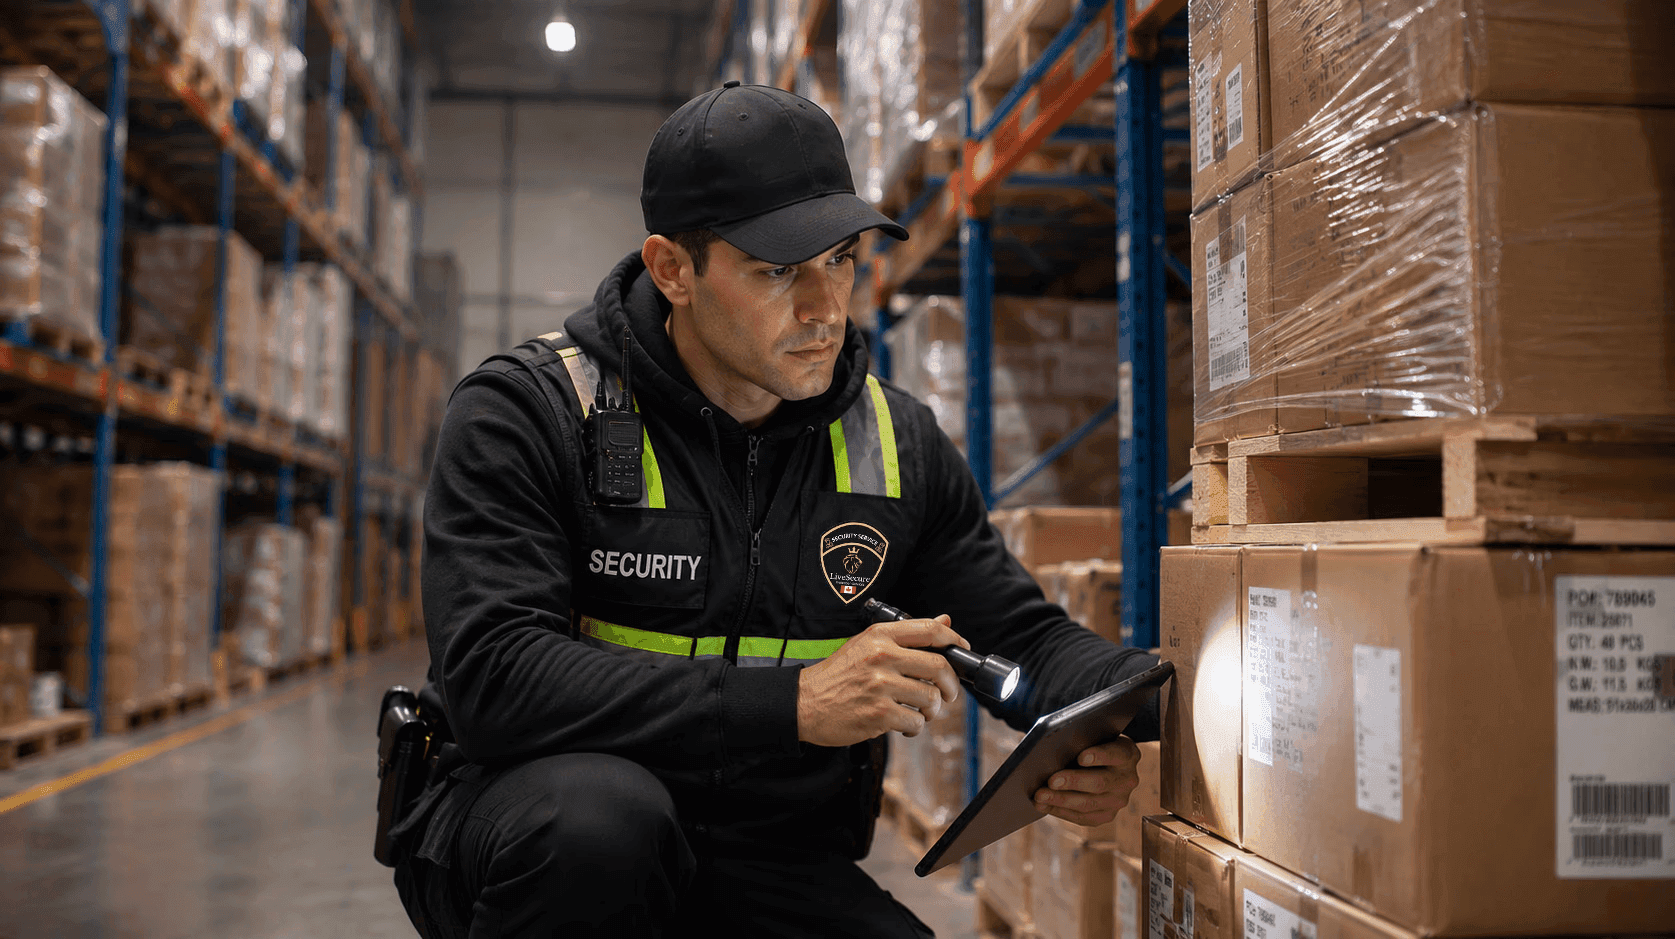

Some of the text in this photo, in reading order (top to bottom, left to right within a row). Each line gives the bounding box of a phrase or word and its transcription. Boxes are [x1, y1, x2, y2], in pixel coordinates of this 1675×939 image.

[831, 533, 857, 542] SECURITY
[589, 549, 702, 580] SECURITY
[830, 573, 870, 582] LiveSecure
[1620, 634, 1644, 651] PCS
